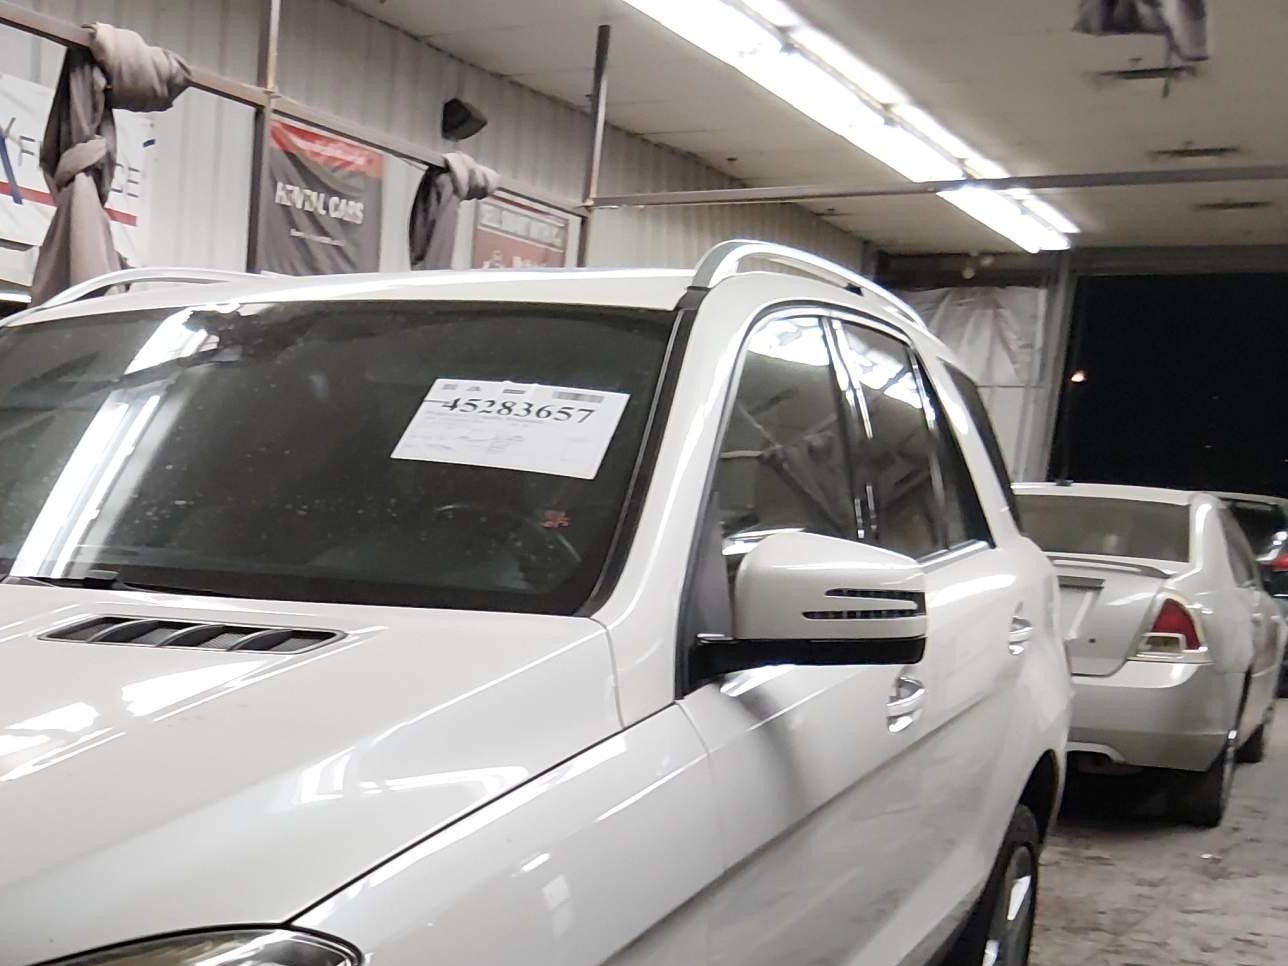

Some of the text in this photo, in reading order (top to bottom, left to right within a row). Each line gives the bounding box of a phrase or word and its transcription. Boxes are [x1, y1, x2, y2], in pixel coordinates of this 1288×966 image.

[17, 135, 141, 198] FICE
[328, 196, 365, 225] CARS
[442, 397, 595, 424] 45283657
